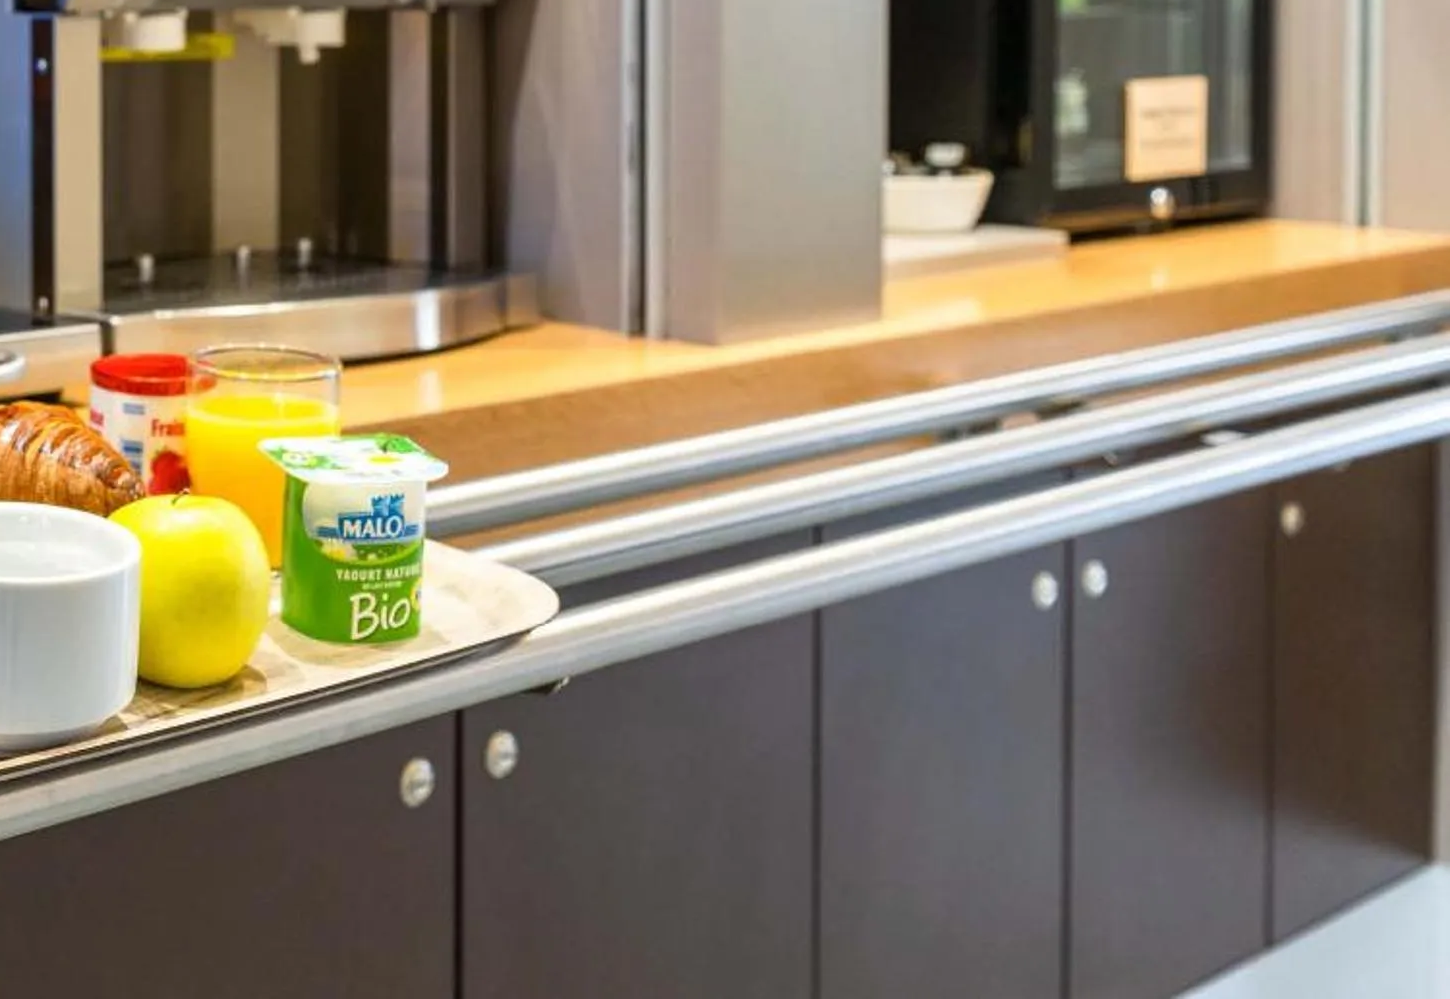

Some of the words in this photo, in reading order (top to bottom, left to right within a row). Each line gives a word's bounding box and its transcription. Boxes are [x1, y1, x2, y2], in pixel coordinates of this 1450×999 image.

[342, 514, 403, 538] MALO
[335, 568, 383, 581] YAOURT
[349, 591, 411, 641] Bio
